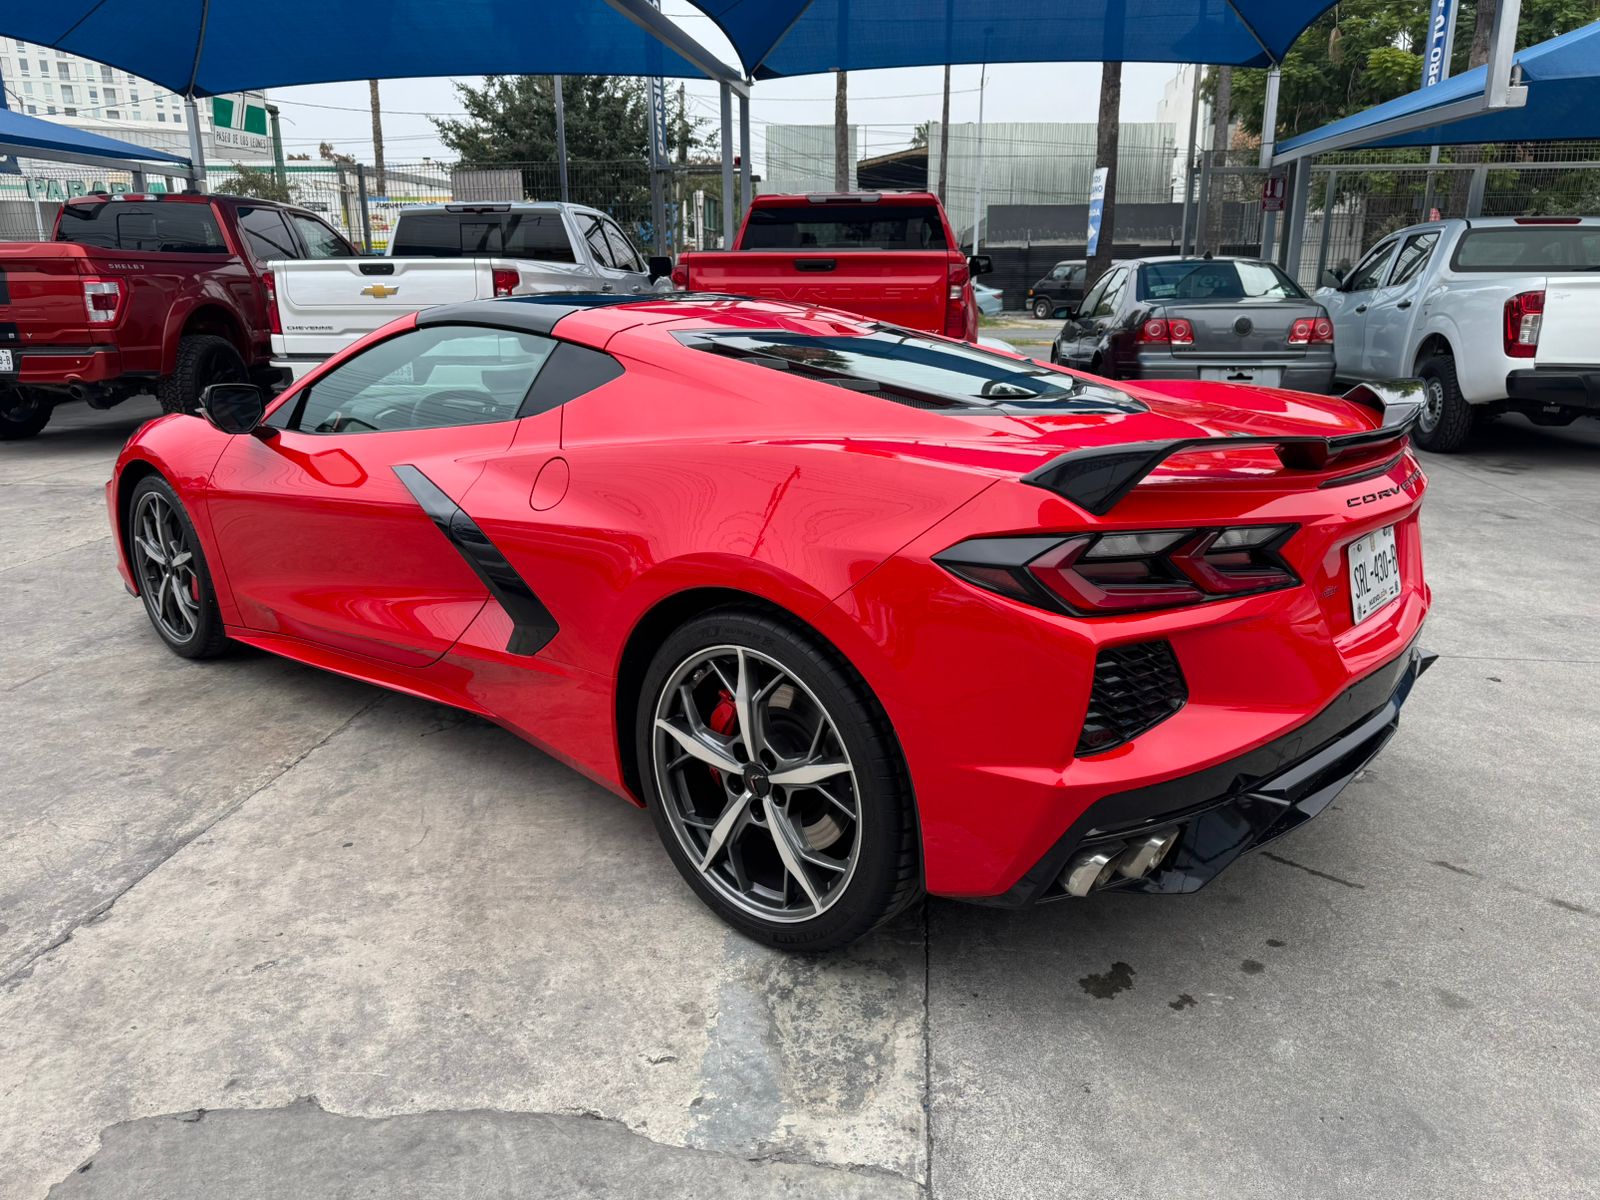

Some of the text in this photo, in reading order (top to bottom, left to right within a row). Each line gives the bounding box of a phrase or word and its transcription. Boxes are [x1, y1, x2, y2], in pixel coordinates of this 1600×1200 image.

[1433, 14, 1446, 44] TU
[216, 130, 231, 144] PASEO
[232, 133, 239, 145] DE
[240, 135, 249, 147] LOS
[1346, 467, 1422, 508] CORVETTE
[1353, 543, 1398, 599] SRL-430-B
